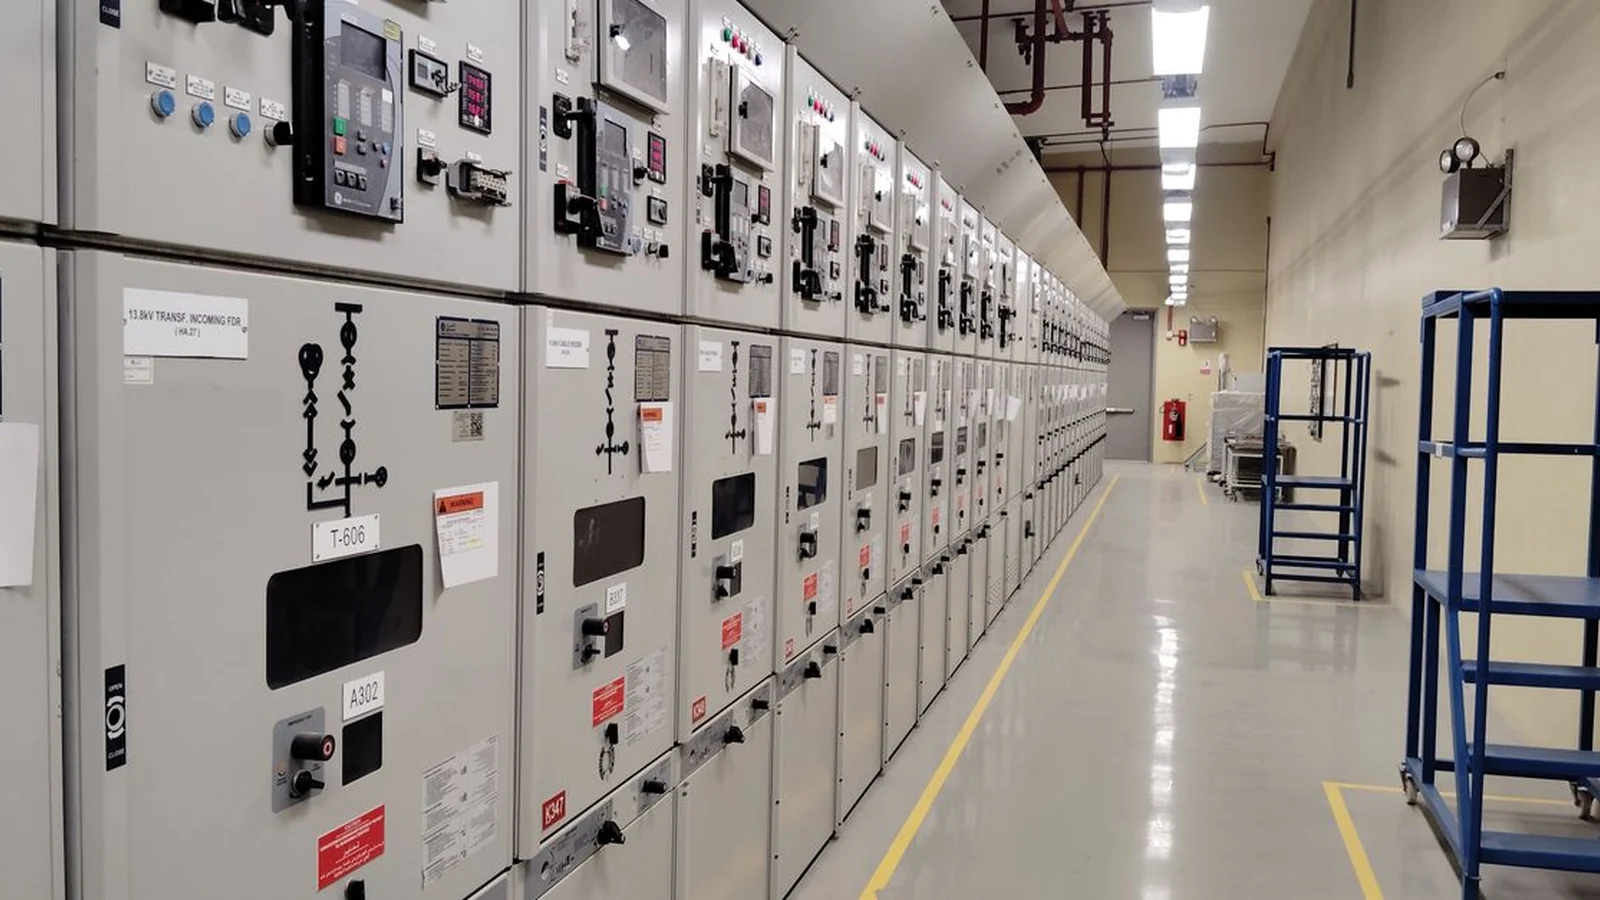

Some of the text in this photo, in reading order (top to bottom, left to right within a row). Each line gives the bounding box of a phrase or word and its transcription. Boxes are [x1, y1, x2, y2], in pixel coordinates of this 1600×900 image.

[129, 309, 154, 321] 13.8kV
[190, 313, 226, 326] INCOMING
[227, 316, 241, 327] FDR
[330, 524, 366, 548] T-606
[350, 681, 379, 710] A302
[545, 796, 564, 823] K347
